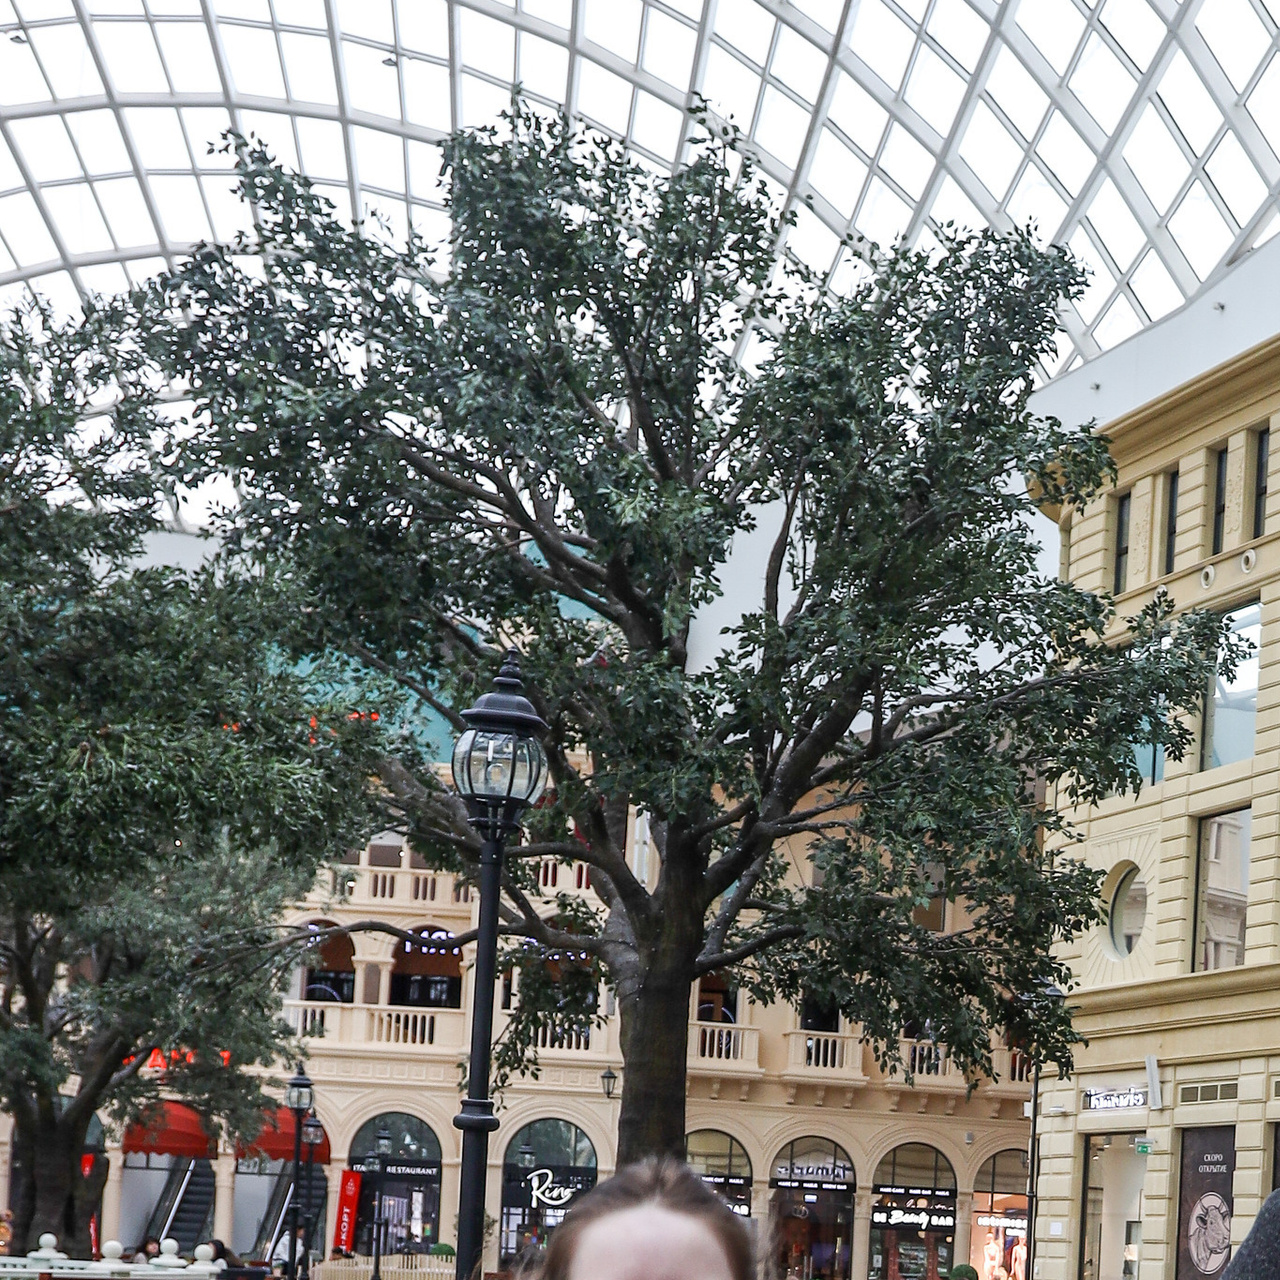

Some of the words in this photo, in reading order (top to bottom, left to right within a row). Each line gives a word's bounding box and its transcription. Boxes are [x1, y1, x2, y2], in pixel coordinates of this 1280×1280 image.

[1203, 1153, 1223, 1162] СКОРО
[386, 1165, 438, 1176] RESTAURANT
[1198, 1164, 1227, 1173] ОТКРЫТИЕ
[526, 1168, 577, 1209] Rino
